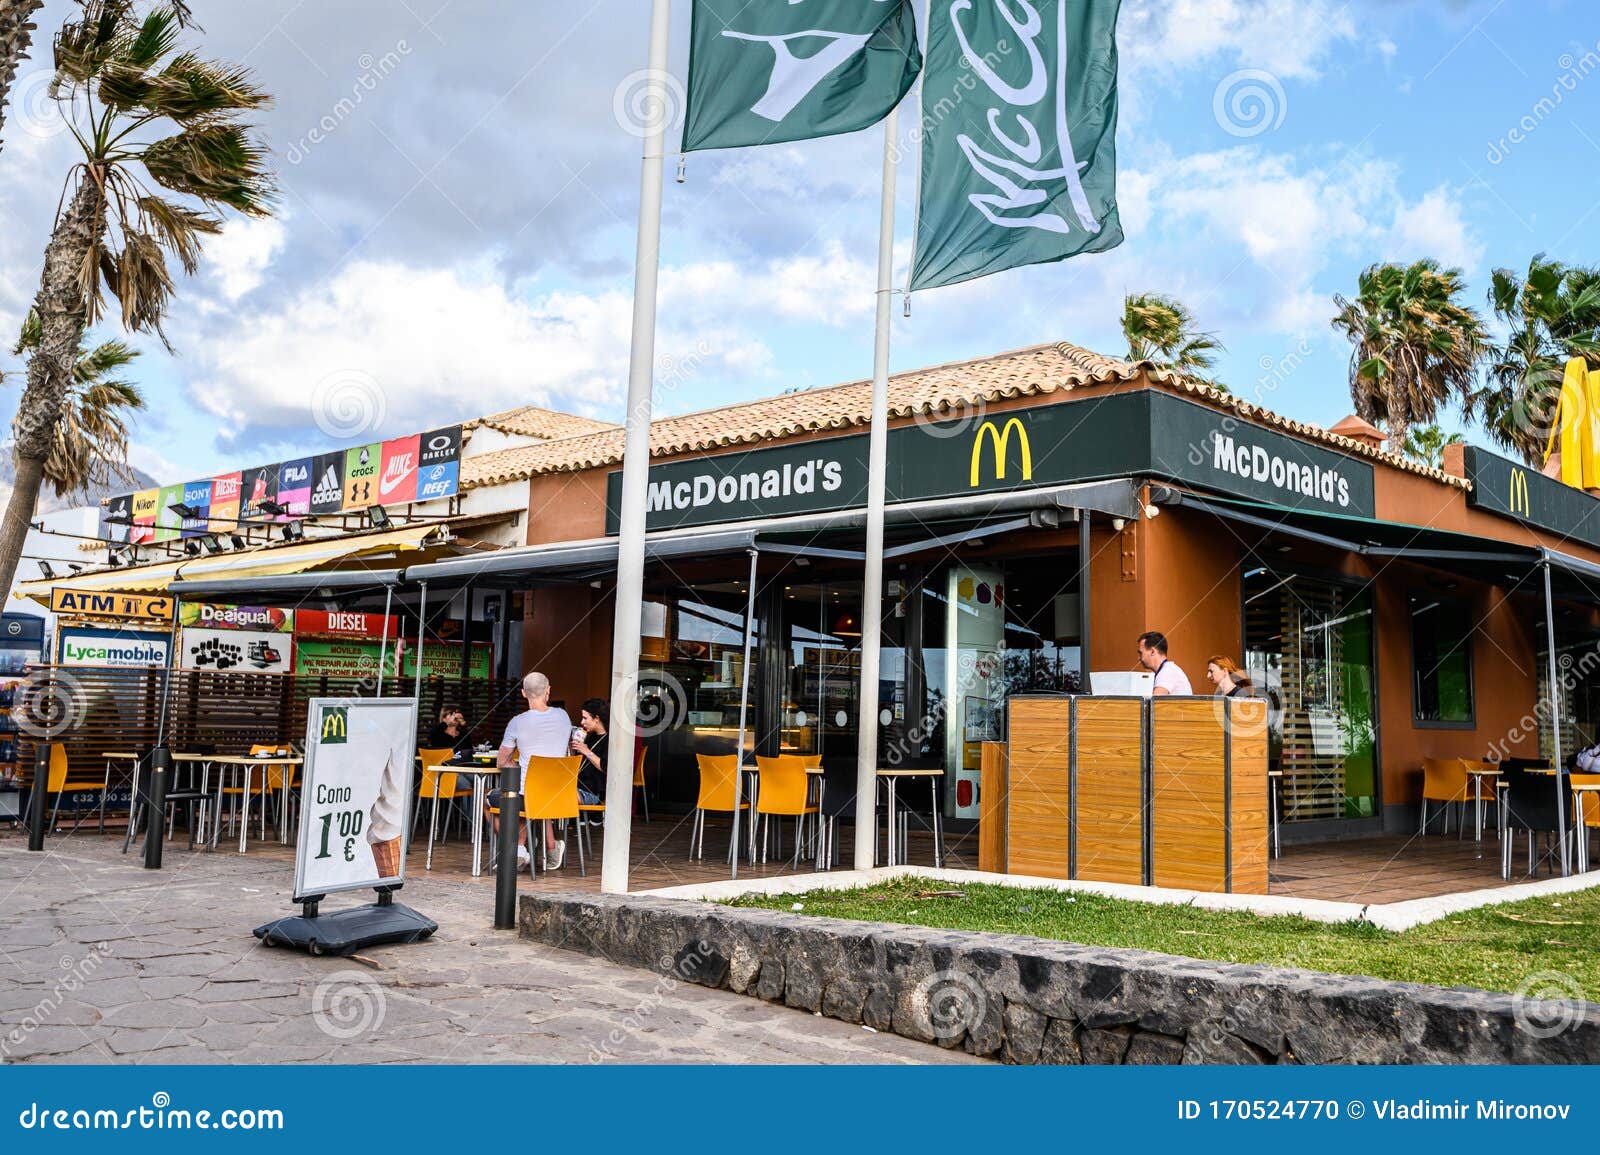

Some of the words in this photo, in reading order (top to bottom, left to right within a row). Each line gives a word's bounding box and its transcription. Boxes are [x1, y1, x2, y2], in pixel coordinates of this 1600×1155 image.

[422, 448, 456, 461] OAKLEY
[284, 465, 308, 482] FILA
[351, 466, 374, 478] crocs
[387, 452, 413, 477] NIKE
[1213, 433, 1350, 508] McDonald's
[185, 487, 211, 502] SONY
[215, 478, 238, 497] DIESEL
[421, 479, 452, 495] REEF
[645, 458, 843, 513] McDonald's
[136, 499, 155, 511] Nikon
[311, 488, 342, 505] adidas
[60, 592, 115, 613] ATM
[328, 612, 368, 631] DIESEL
[66, 643, 164, 661] Lycamobile
[316, 784, 352, 804] Cono
